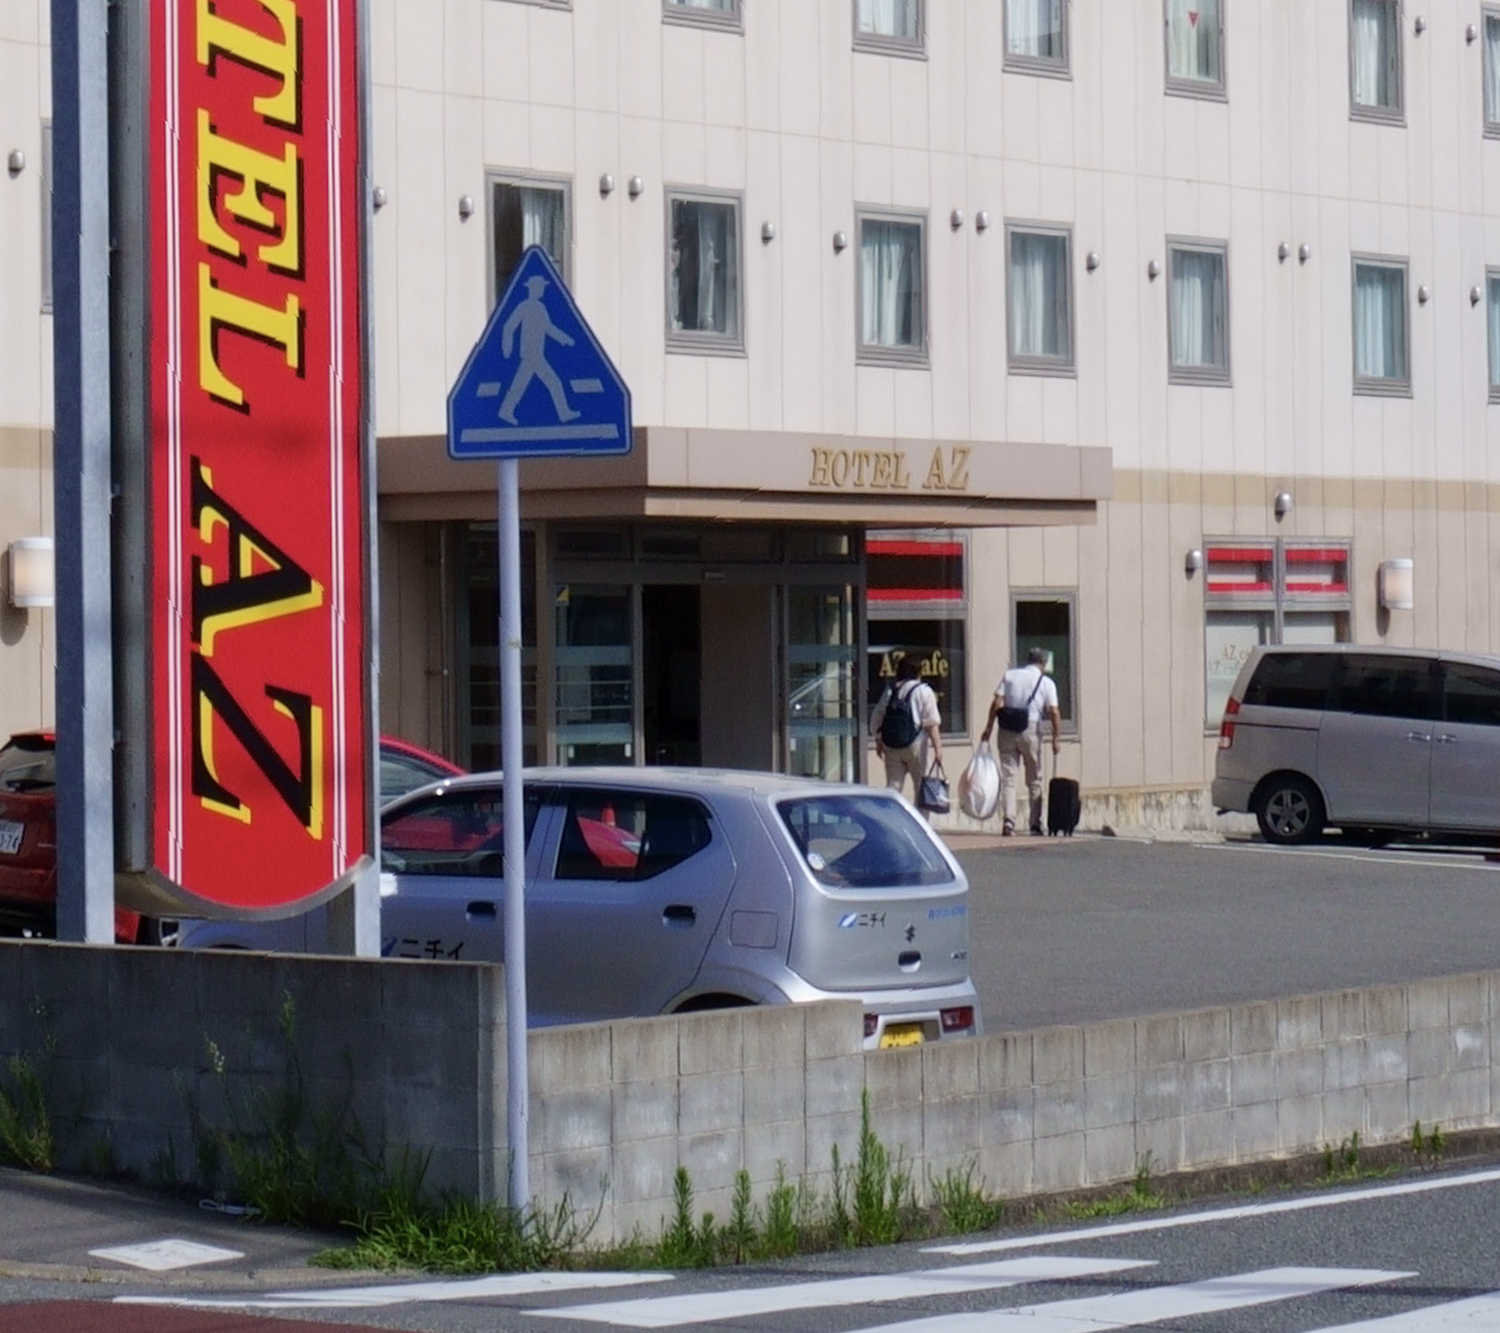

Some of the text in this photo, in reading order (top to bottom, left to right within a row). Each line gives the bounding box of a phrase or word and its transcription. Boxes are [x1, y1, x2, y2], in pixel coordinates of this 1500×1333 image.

[808, 445, 972, 491] HOTEL AZ
[190, 453, 324, 841] AZ
[858, 912, 887, 928] ニチイ
[399, 939, 465, 961] ニチイ
